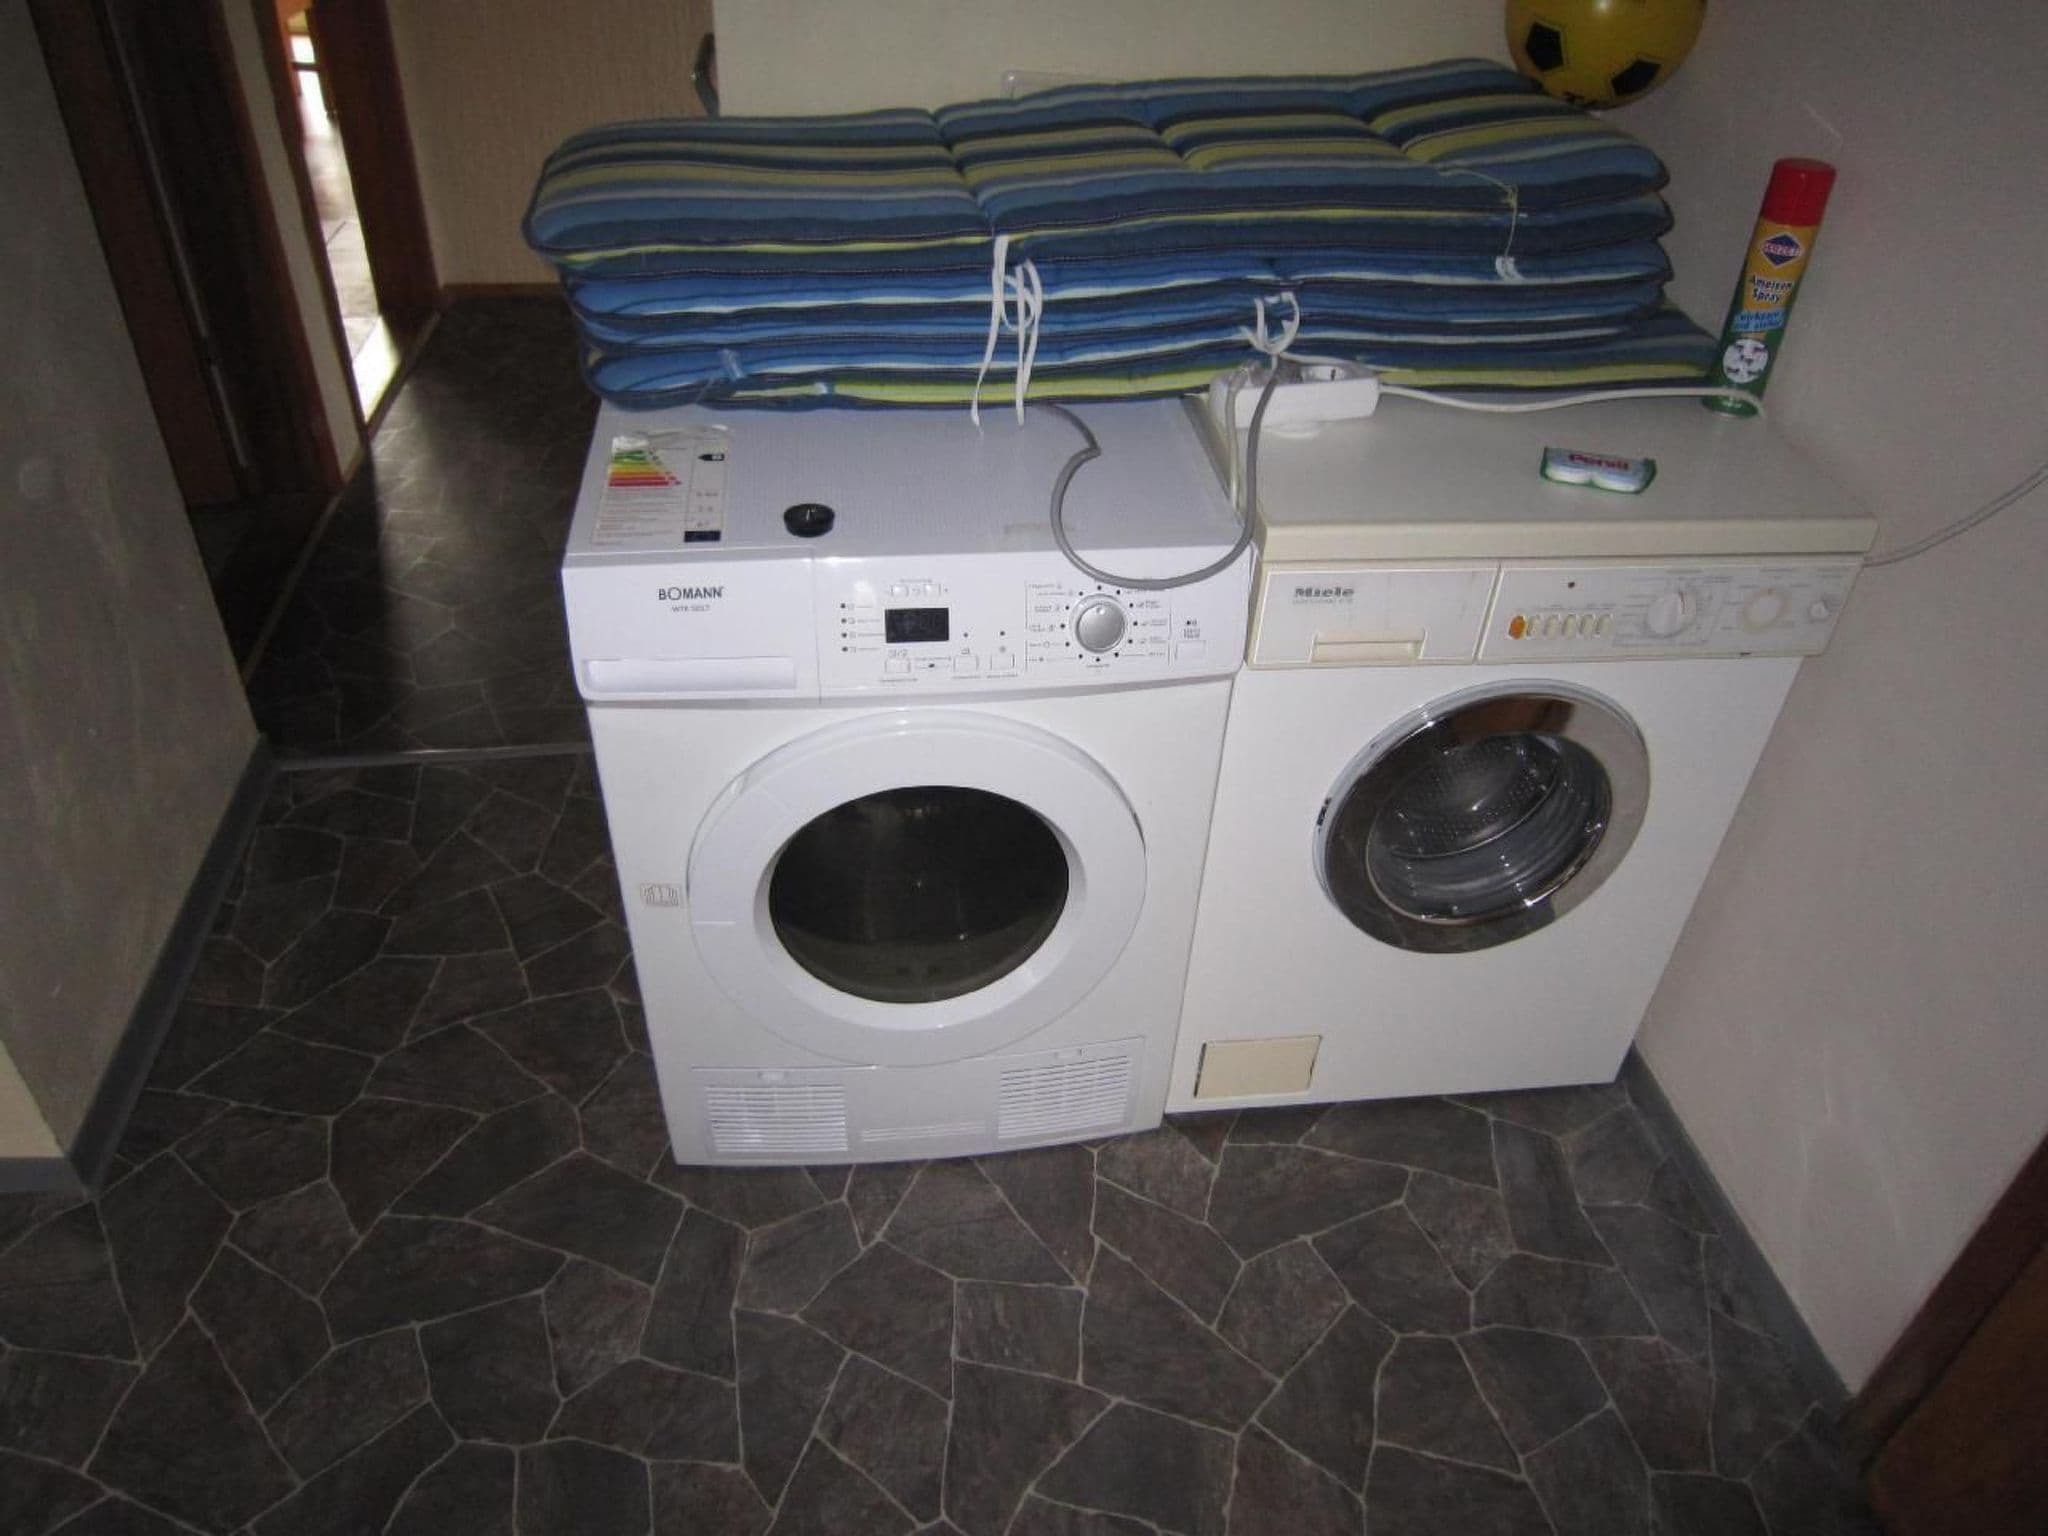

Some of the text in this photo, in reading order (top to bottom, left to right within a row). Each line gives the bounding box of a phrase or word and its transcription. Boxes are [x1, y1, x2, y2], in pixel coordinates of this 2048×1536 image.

[1752, 287, 1780, 304] Spray
[658, 586, 723, 601] BOMANN
[1294, 586, 1355, 598] Miele
